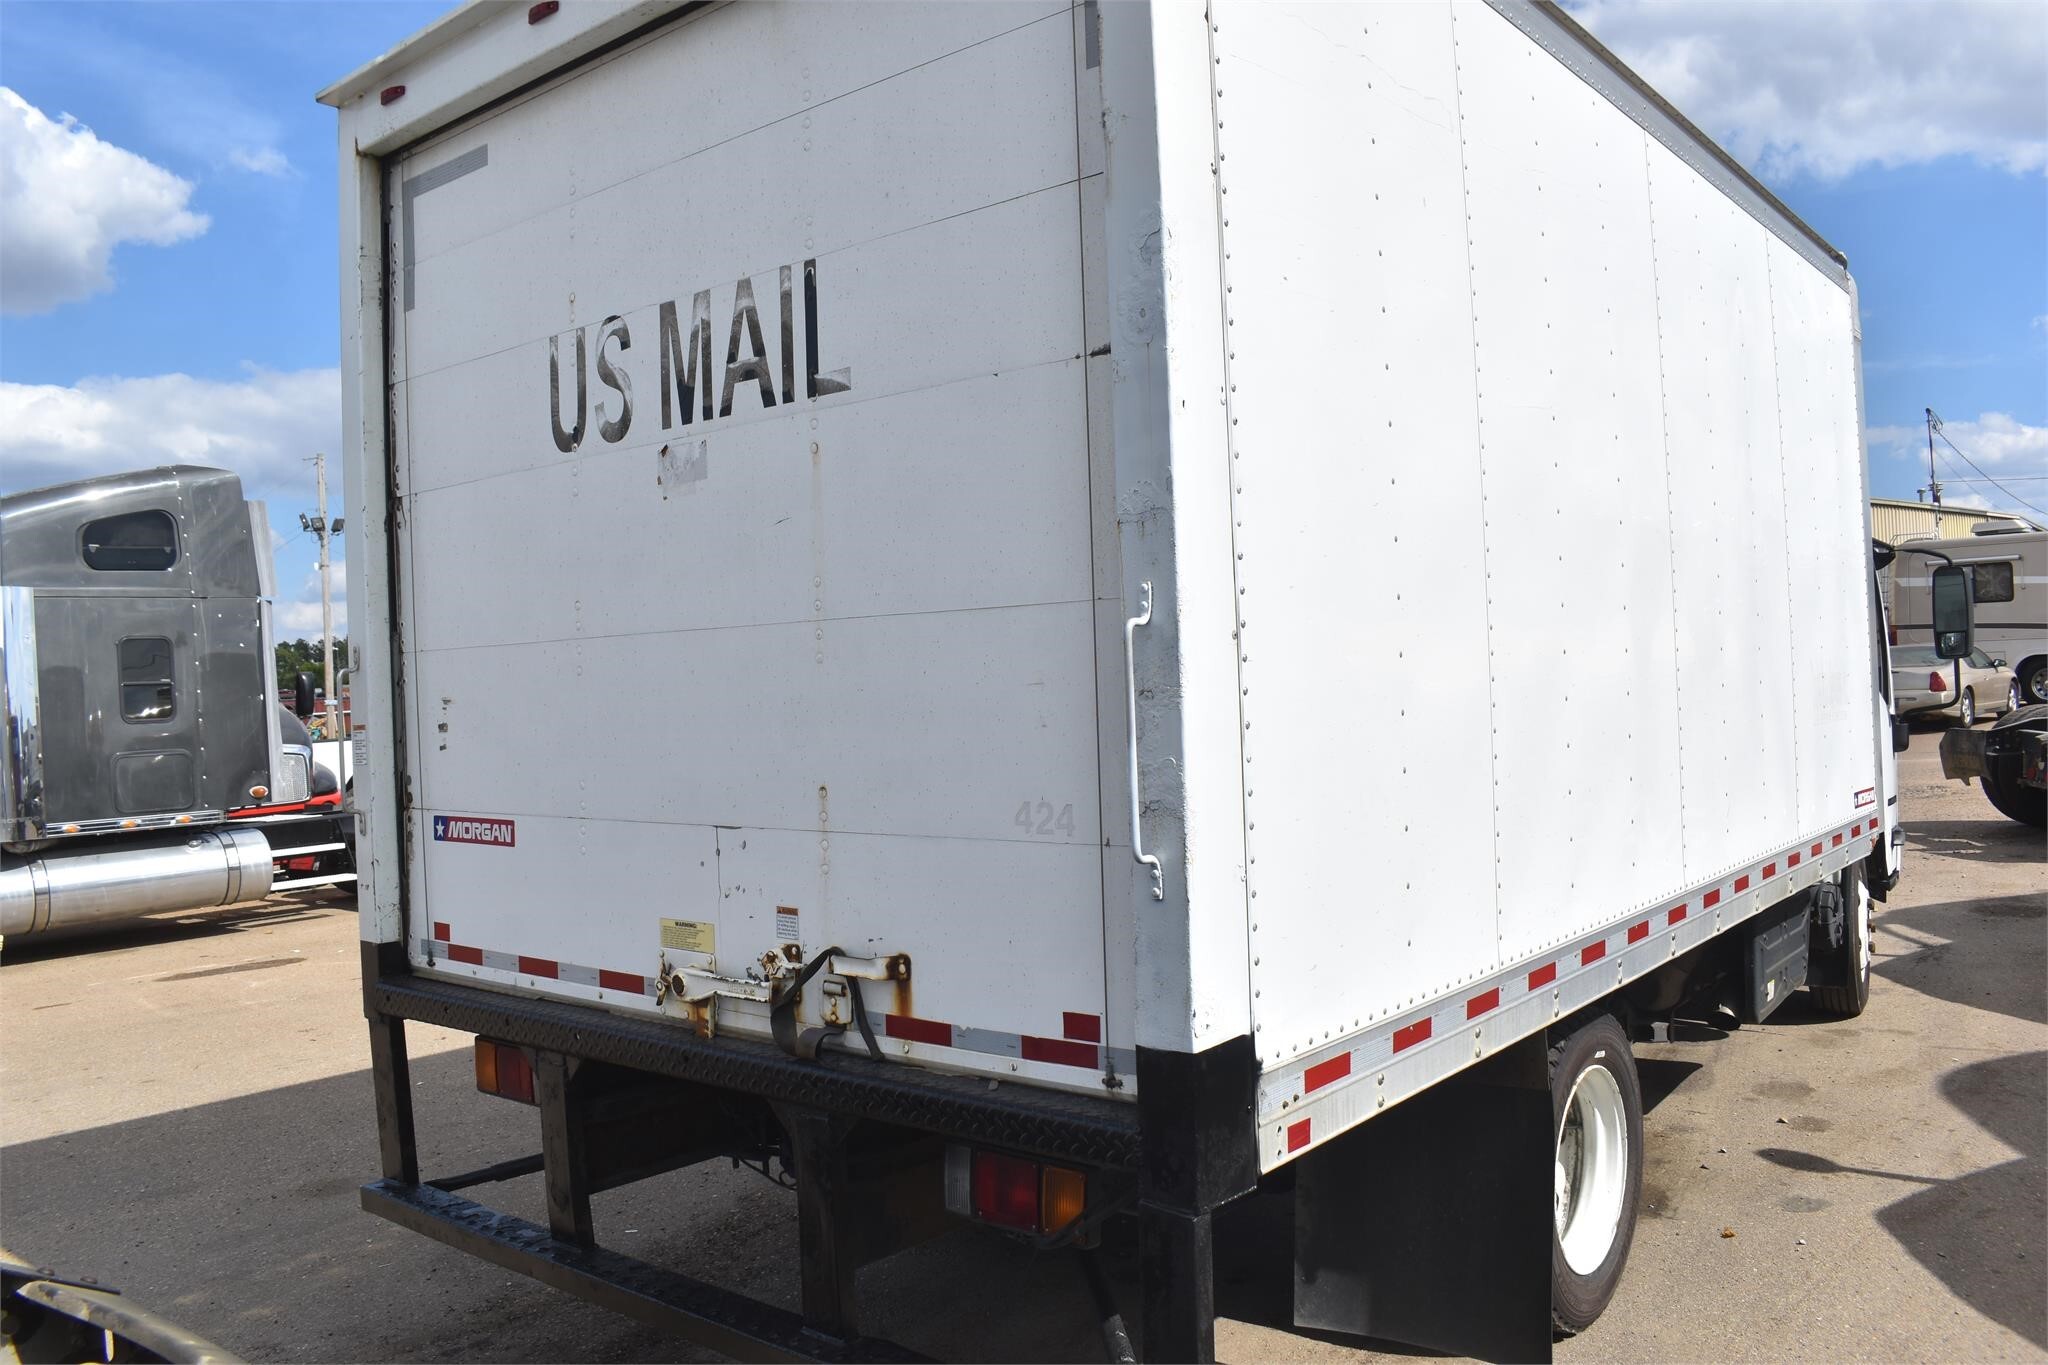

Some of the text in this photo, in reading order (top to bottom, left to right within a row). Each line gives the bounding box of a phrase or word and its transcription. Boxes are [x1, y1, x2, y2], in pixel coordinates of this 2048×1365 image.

[549, 258, 851, 453] US MAIL
[448, 821, 512, 843] MORGAN
[1014, 801, 1076, 837] 424
